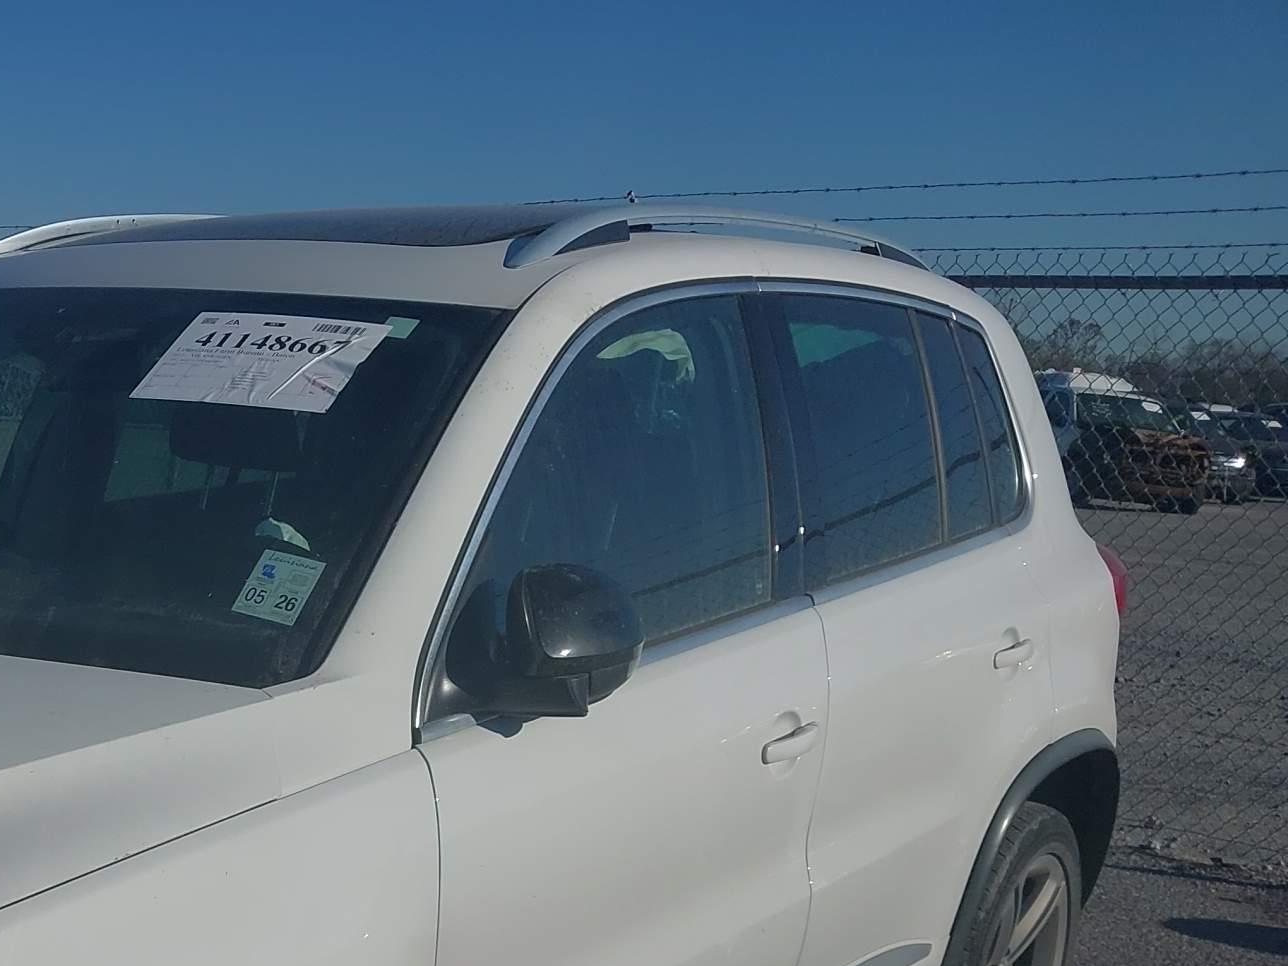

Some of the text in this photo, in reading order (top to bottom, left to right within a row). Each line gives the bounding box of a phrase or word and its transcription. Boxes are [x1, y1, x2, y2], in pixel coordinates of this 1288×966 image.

[195, 331, 353, 356] 41148667
[244, 587, 268, 604] 05
[273, 594, 298, 612] 26
